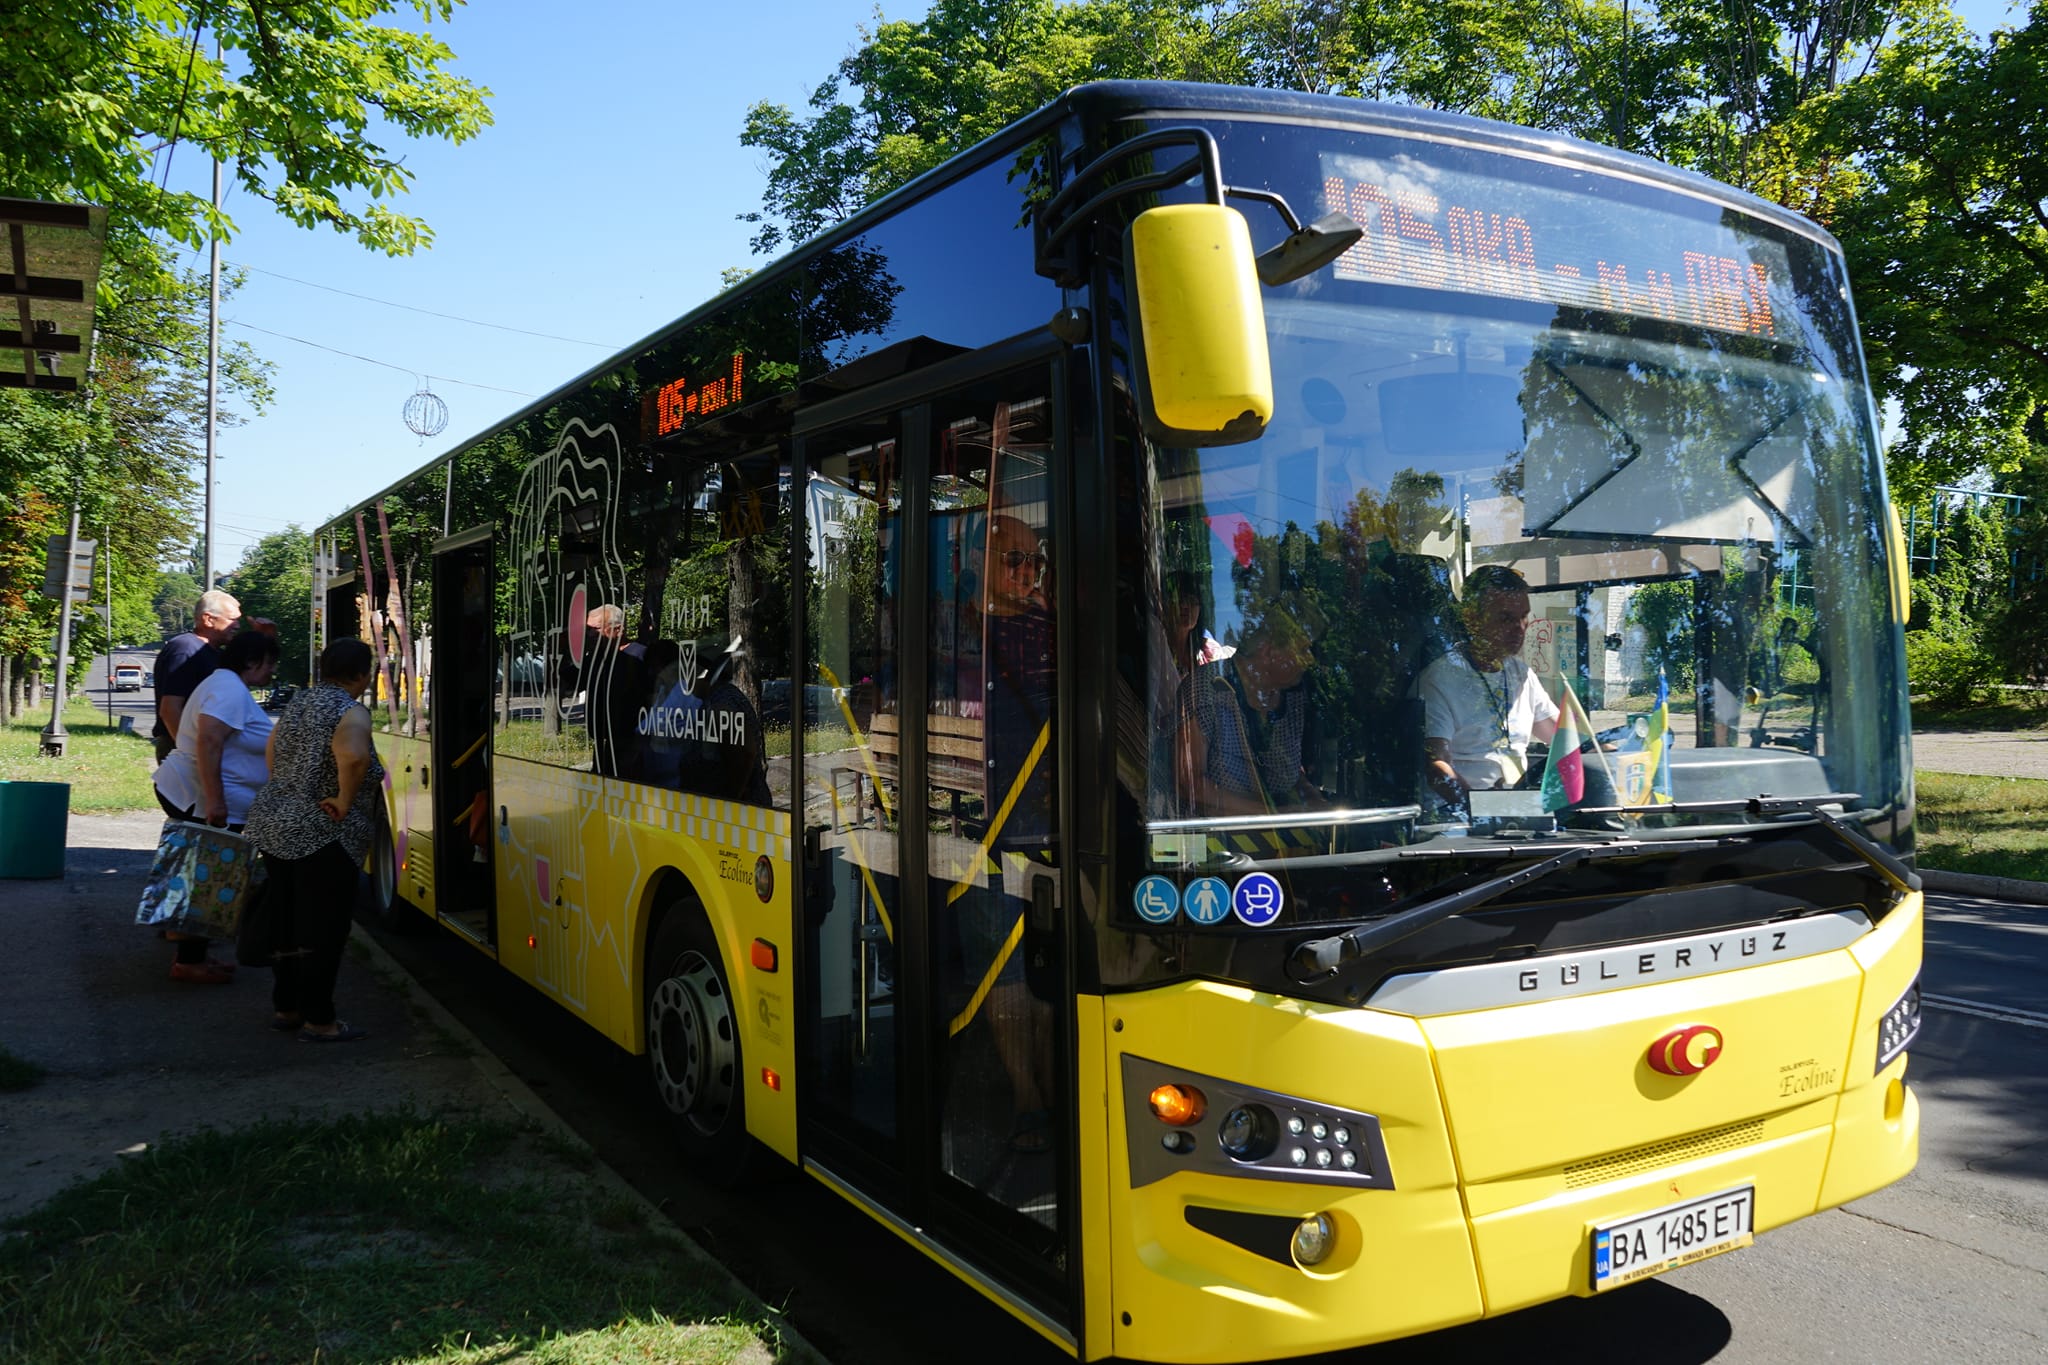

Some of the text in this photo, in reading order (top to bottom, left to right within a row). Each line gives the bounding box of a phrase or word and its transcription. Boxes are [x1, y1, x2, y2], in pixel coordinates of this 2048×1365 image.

[638, 706, 745, 747] ОЛЕКСАНДРІЯ
[719, 859, 754, 887] Ecoline
[1518, 931, 1786, 992] GÜLERYÜZ
[1779, 1066, 1837, 1098] Ecoline
[1612, 1228, 1648, 1269] BA
[1656, 1209, 1708, 1255] 1485
[1714, 1197, 1747, 1238] ET
